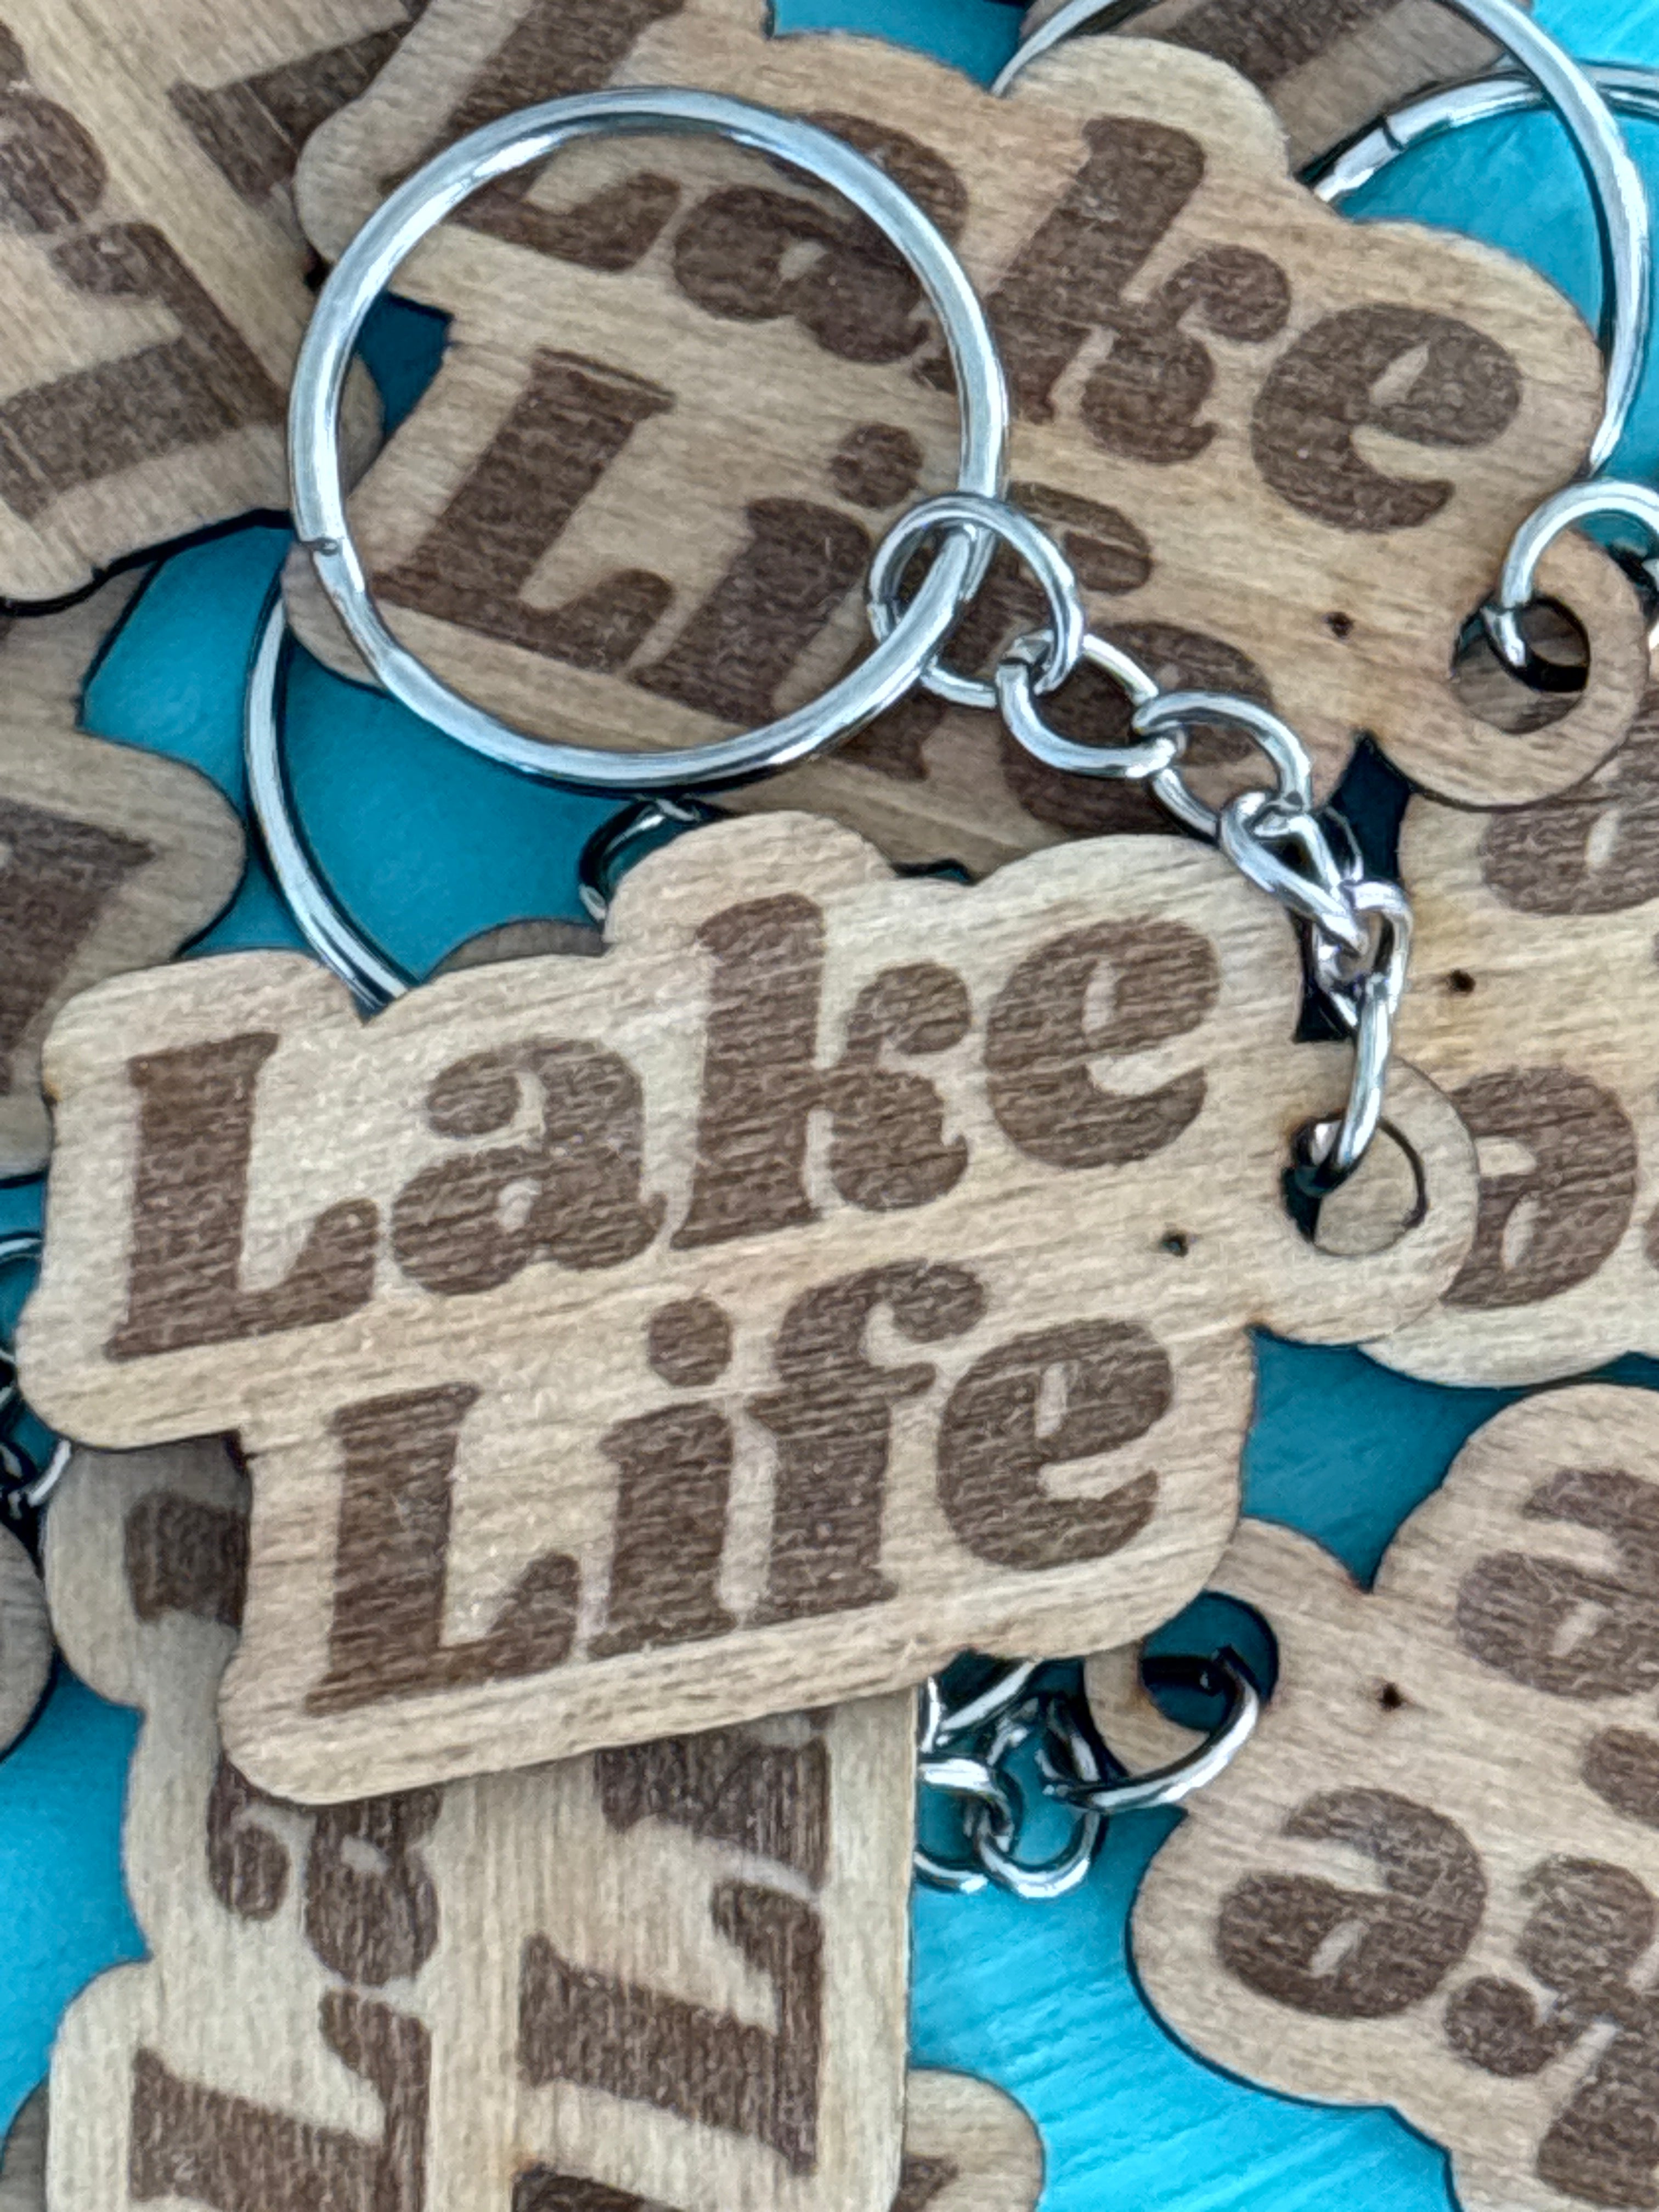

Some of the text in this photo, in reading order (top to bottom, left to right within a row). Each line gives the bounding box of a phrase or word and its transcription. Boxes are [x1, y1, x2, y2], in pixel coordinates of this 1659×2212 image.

[376, 0, 1524, 534] Lake
[104, 892, 1221, 1359] Lake
[303, 1257, 1174, 1716] Life
